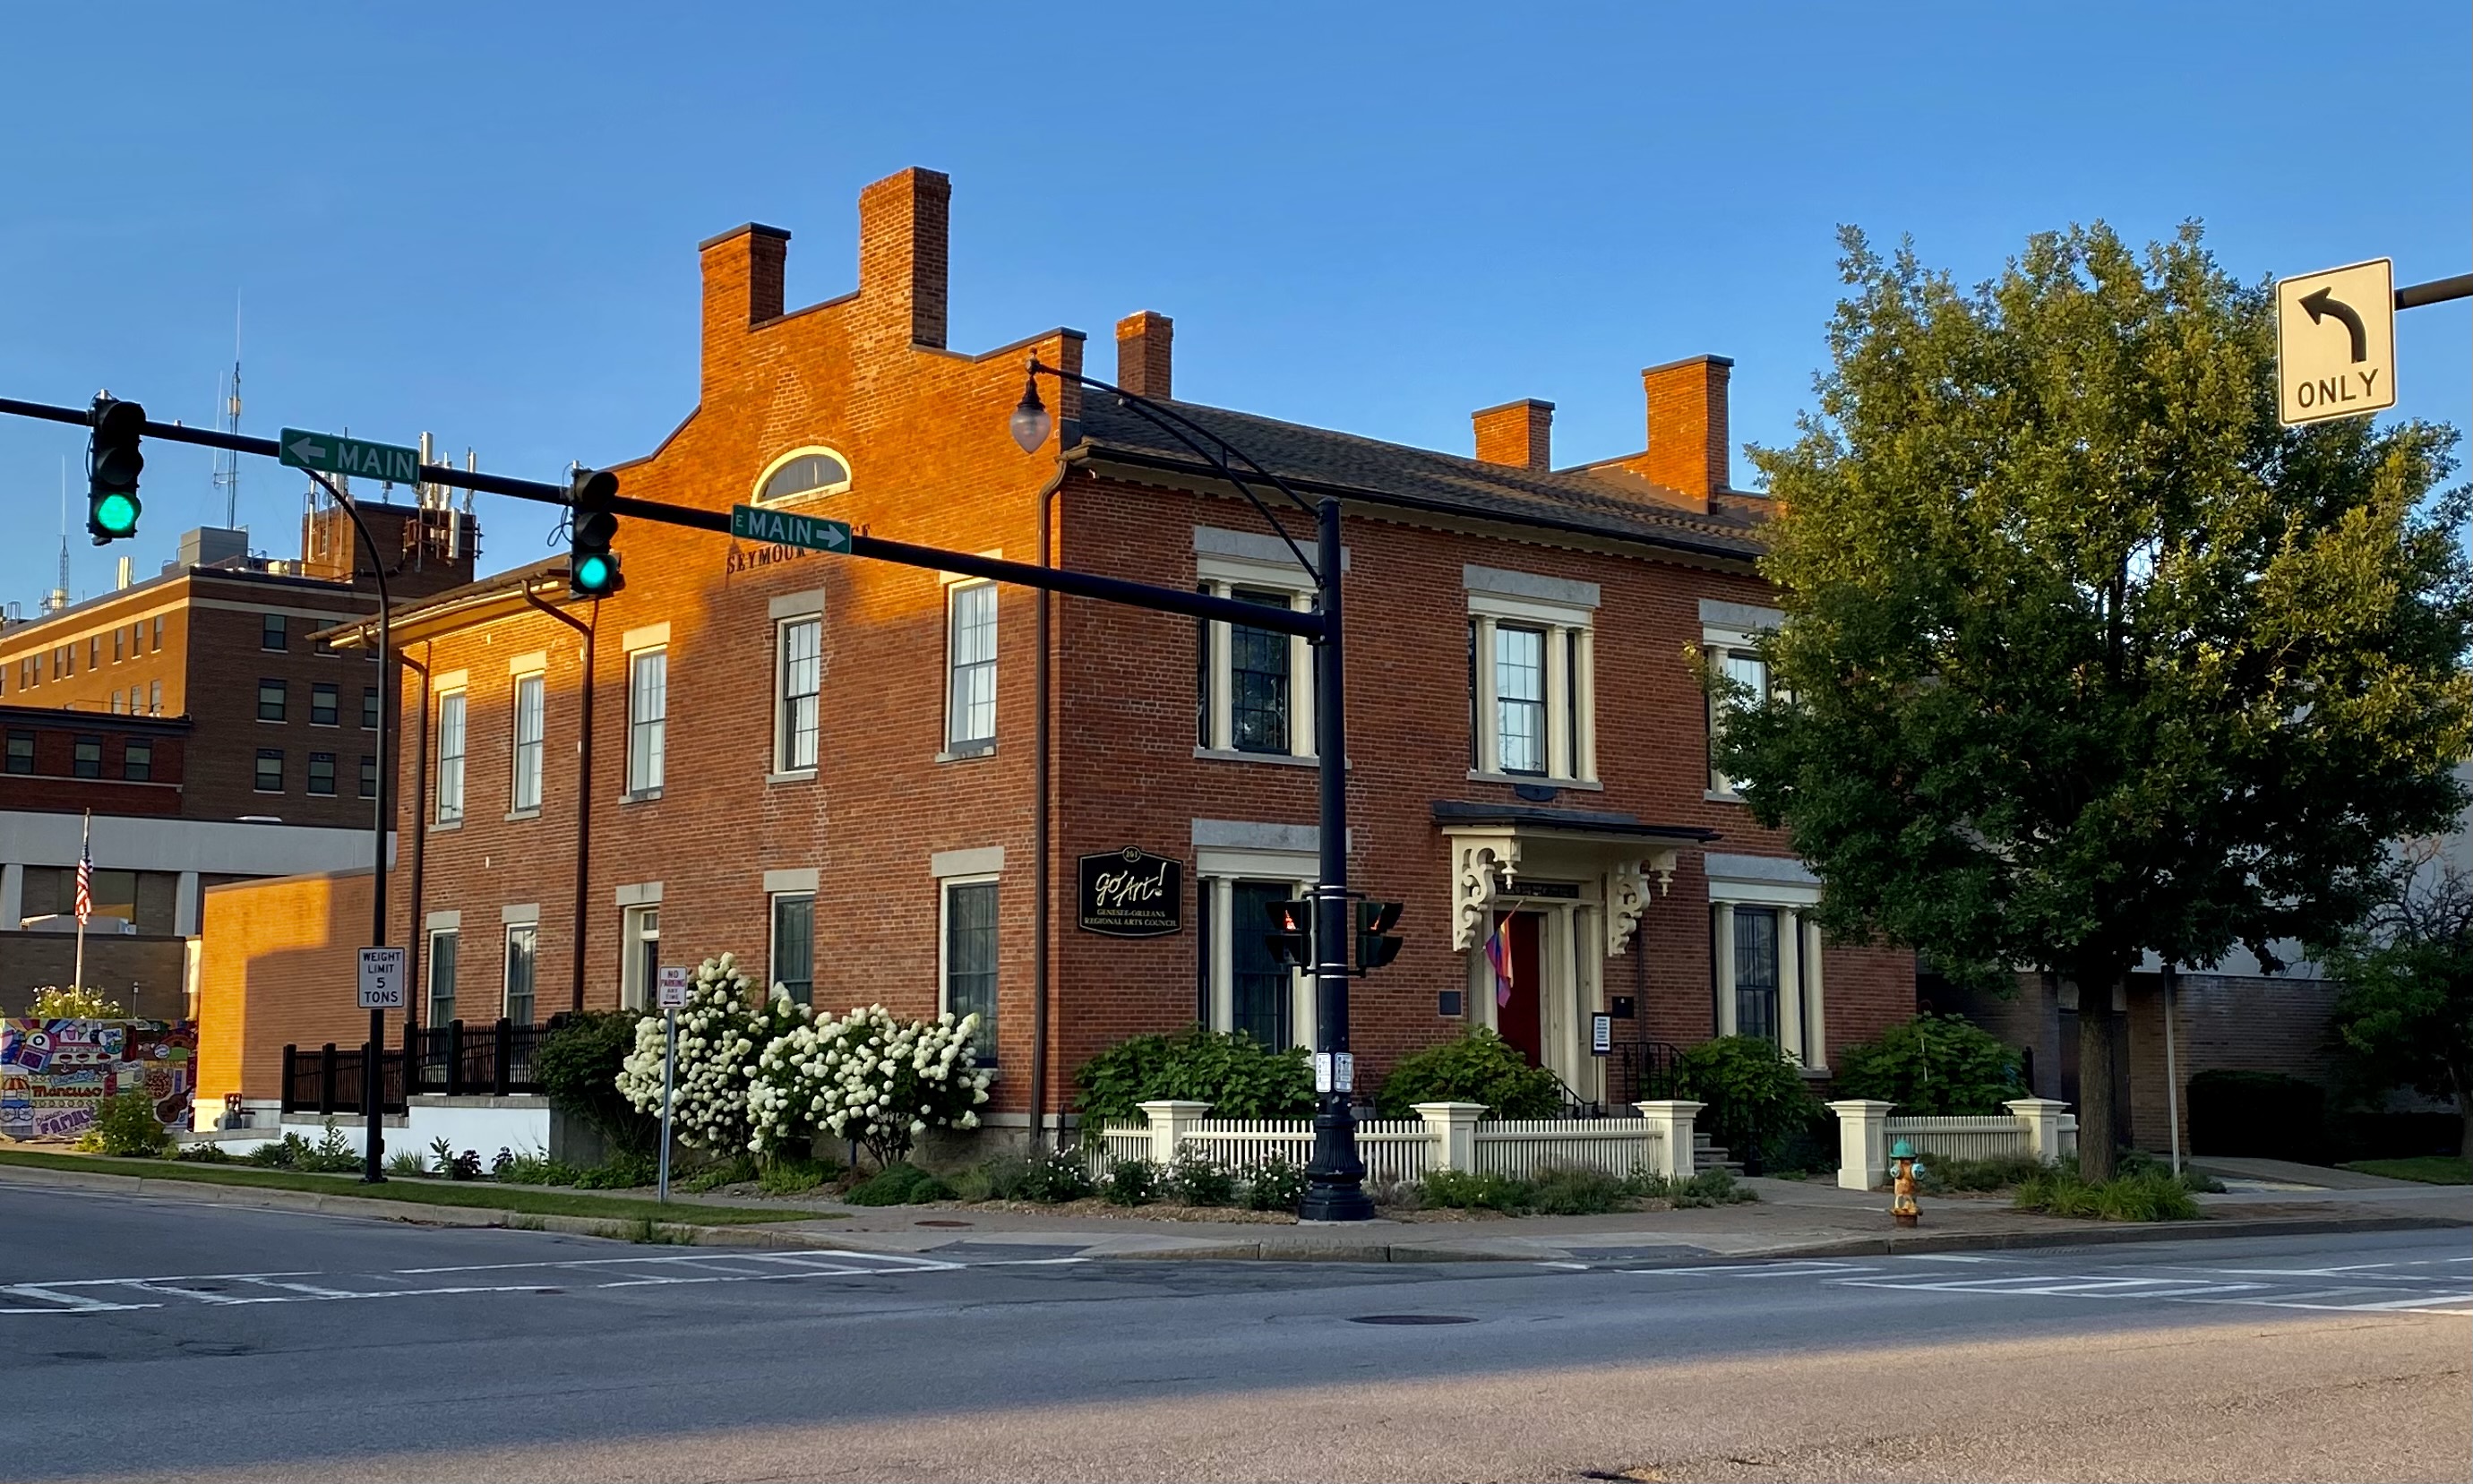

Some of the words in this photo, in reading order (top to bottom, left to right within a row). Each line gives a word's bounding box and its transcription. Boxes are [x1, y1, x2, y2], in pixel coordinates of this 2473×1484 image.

[2297, 368, 2379, 408] ONLY
[337, 442, 414, 480] MAIN
[735, 514, 744, 528] E
[748, 510, 811, 545] MAIN
[1084, 916, 1123, 926] REGIONAL
[1123, 918, 1143, 926] ARTS
[1144, 919, 1178, 927] COUNCIL
[363, 952, 401, 962] WEIGHT
[367, 964, 395, 974] LIMIT
[667, 970, 679, 978] NO
[376, 976, 386, 989] 5
[364, 991, 399, 1003] TONS
[30, 1085, 103, 1098] Mancuso
[39, 1106, 95, 1135] FAMILY
